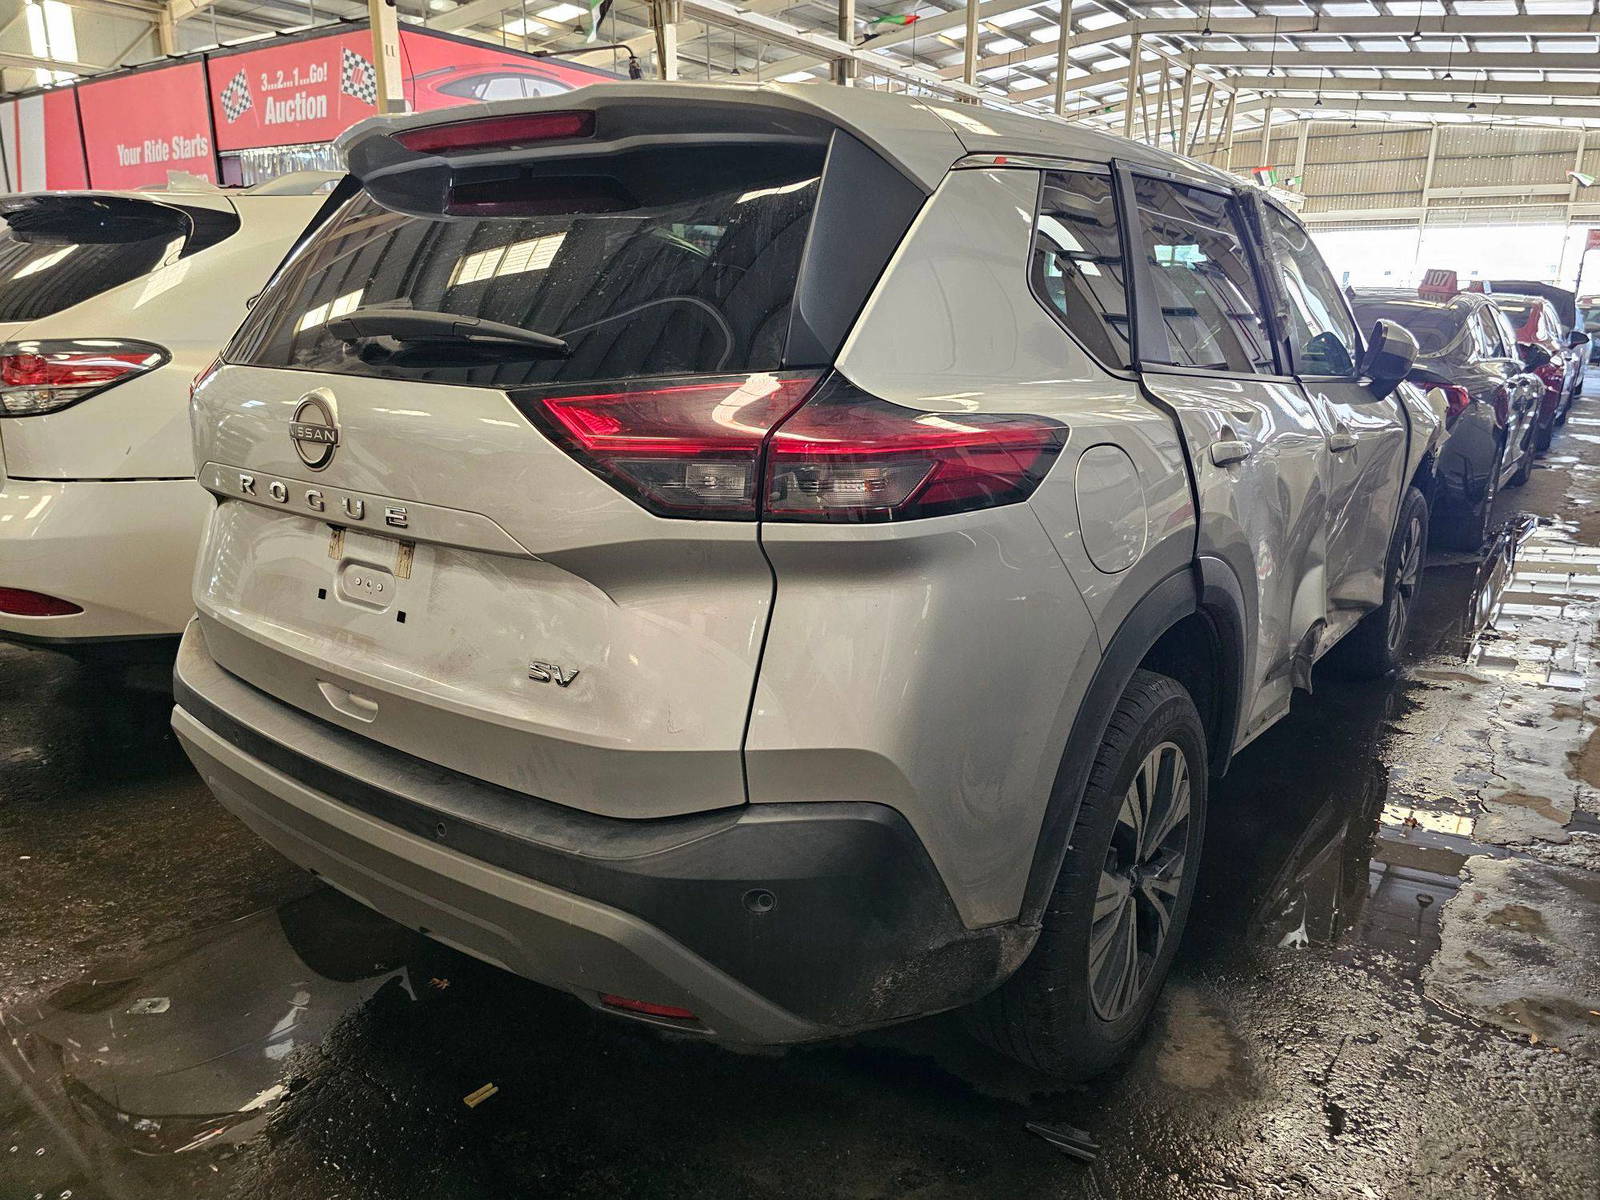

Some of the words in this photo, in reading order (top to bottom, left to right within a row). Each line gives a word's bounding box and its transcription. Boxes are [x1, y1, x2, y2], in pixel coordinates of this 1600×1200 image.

[264, 91, 327, 125] Auction
[117, 144, 141, 167] Your
[144, 138, 169, 163] Ride
[172, 133, 208, 160] Starts
[1427, 270, 1451, 287] 107
[239, 473, 409, 529] ROGUE
[528, 661, 580, 688] SV
